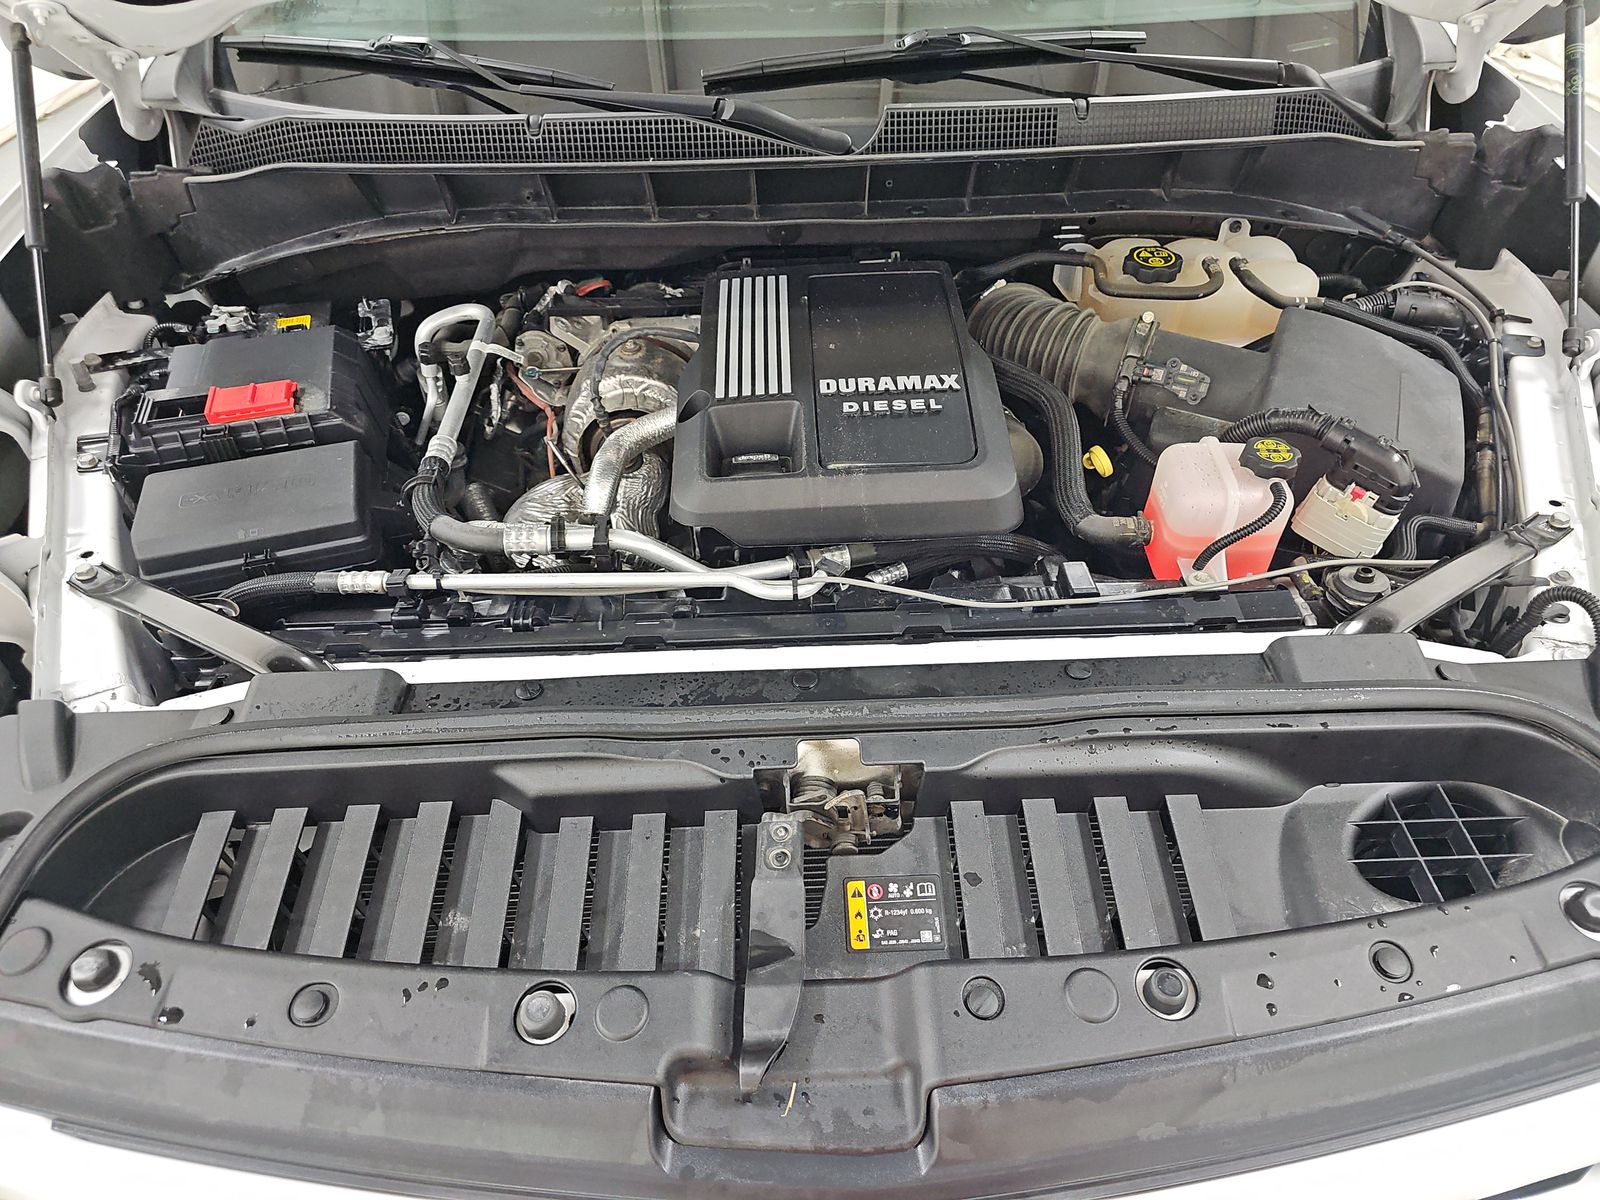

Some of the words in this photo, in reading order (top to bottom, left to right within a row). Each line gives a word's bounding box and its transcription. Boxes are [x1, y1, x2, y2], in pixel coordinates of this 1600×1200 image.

[819, 374, 962, 395] DURAMAX
[842, 398, 943, 414] DIESEL
[886, 929, 898, 937] PAG
